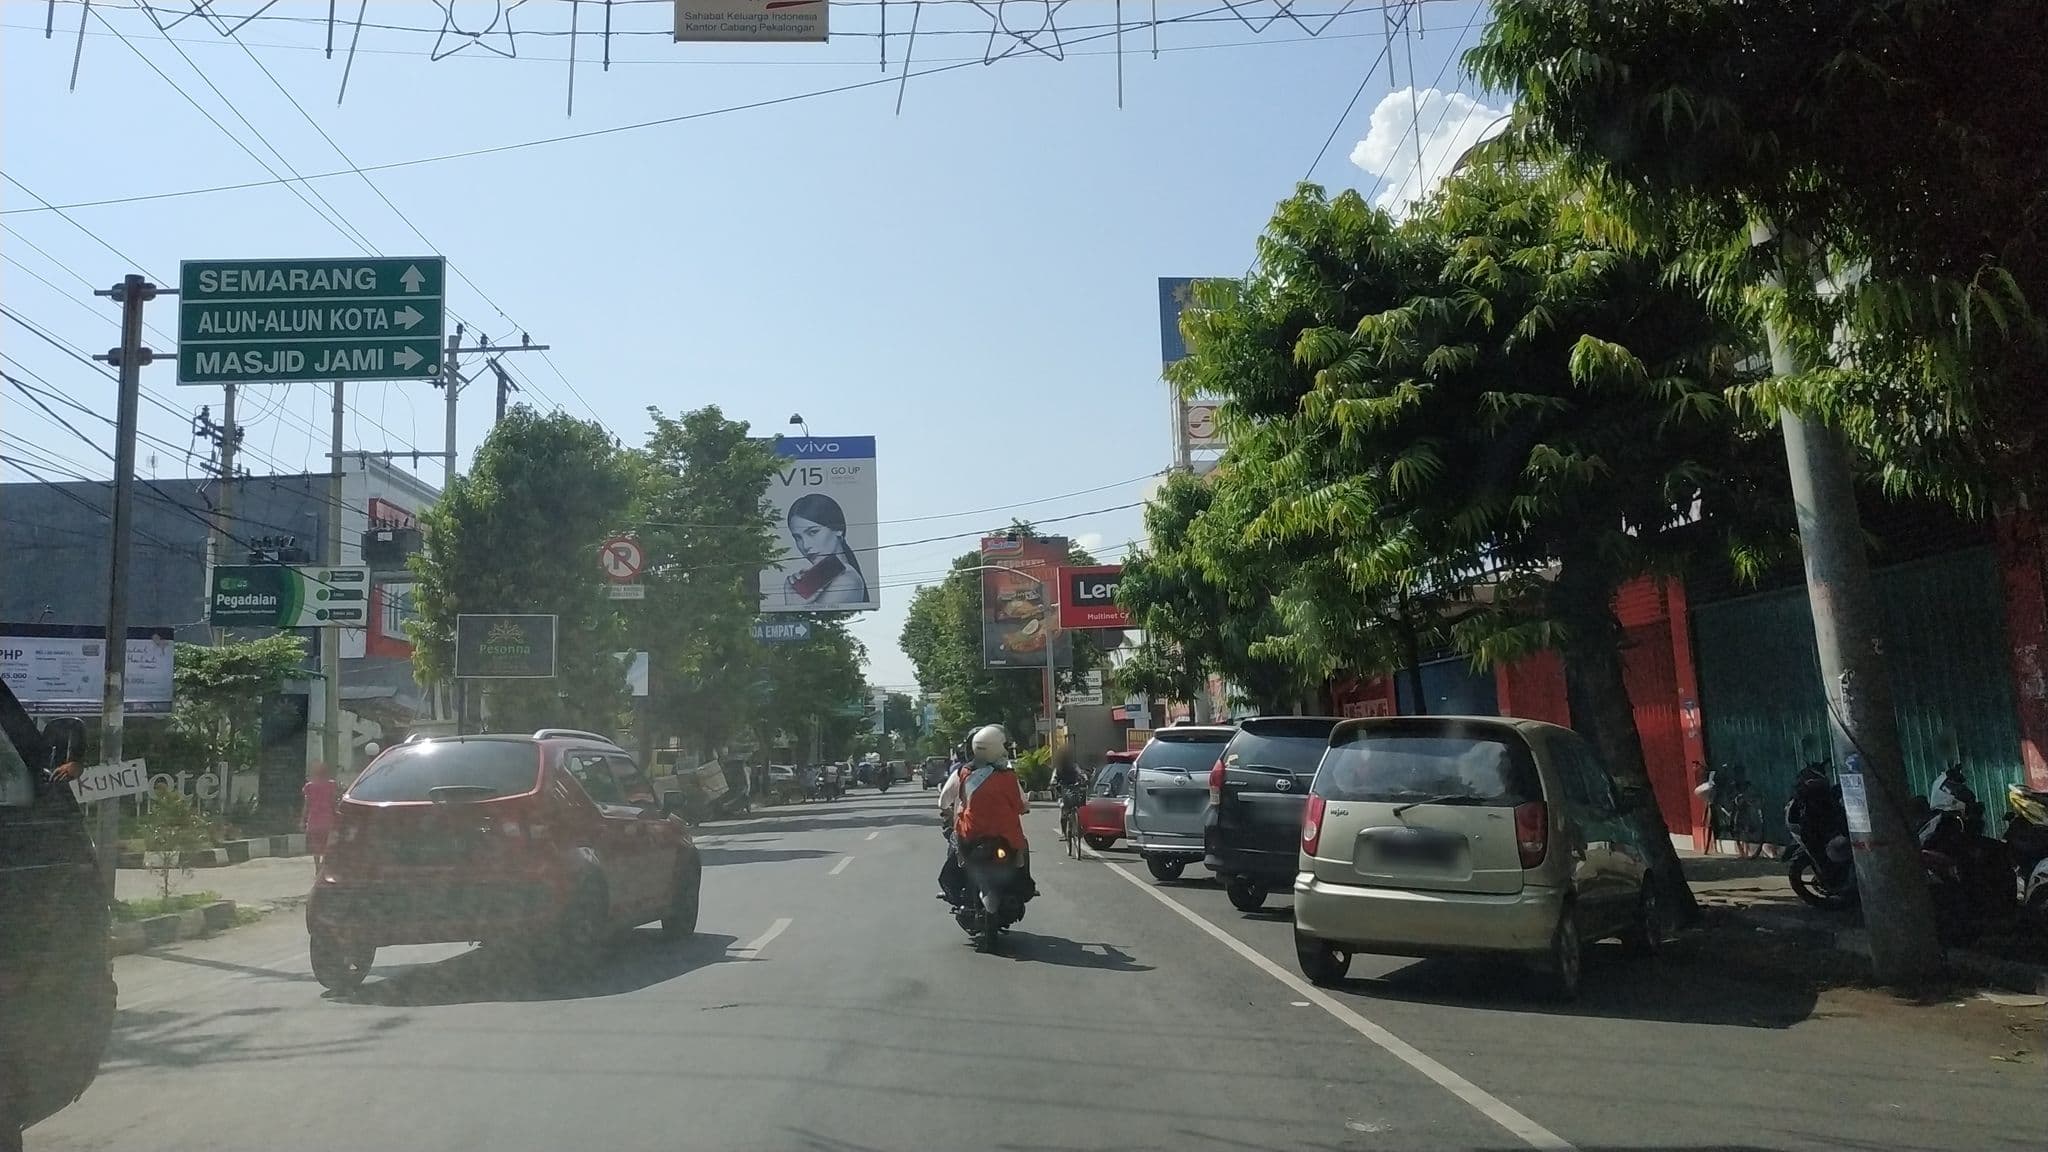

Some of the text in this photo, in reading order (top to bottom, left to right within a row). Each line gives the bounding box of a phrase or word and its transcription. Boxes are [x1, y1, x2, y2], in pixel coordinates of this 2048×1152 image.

[684, 11, 818, 22] Sahabat Keluarga Indonesia
[686, 22, 815, 33] Kantor Cabang Pekalongan
[199, 268, 377, 292] SEMARANG
[197, 307, 389, 334] ALUN-ALUN KOTA
[195, 348, 384, 375] MASJID JAMI
[795, 440, 840, 453] vivo
[848, 466, 860, 474] UP
[216, 593, 277, 608] Pegadaian
[765, 624, 795, 638] EMPAT
[479, 644, 531, 654] Pesonna
